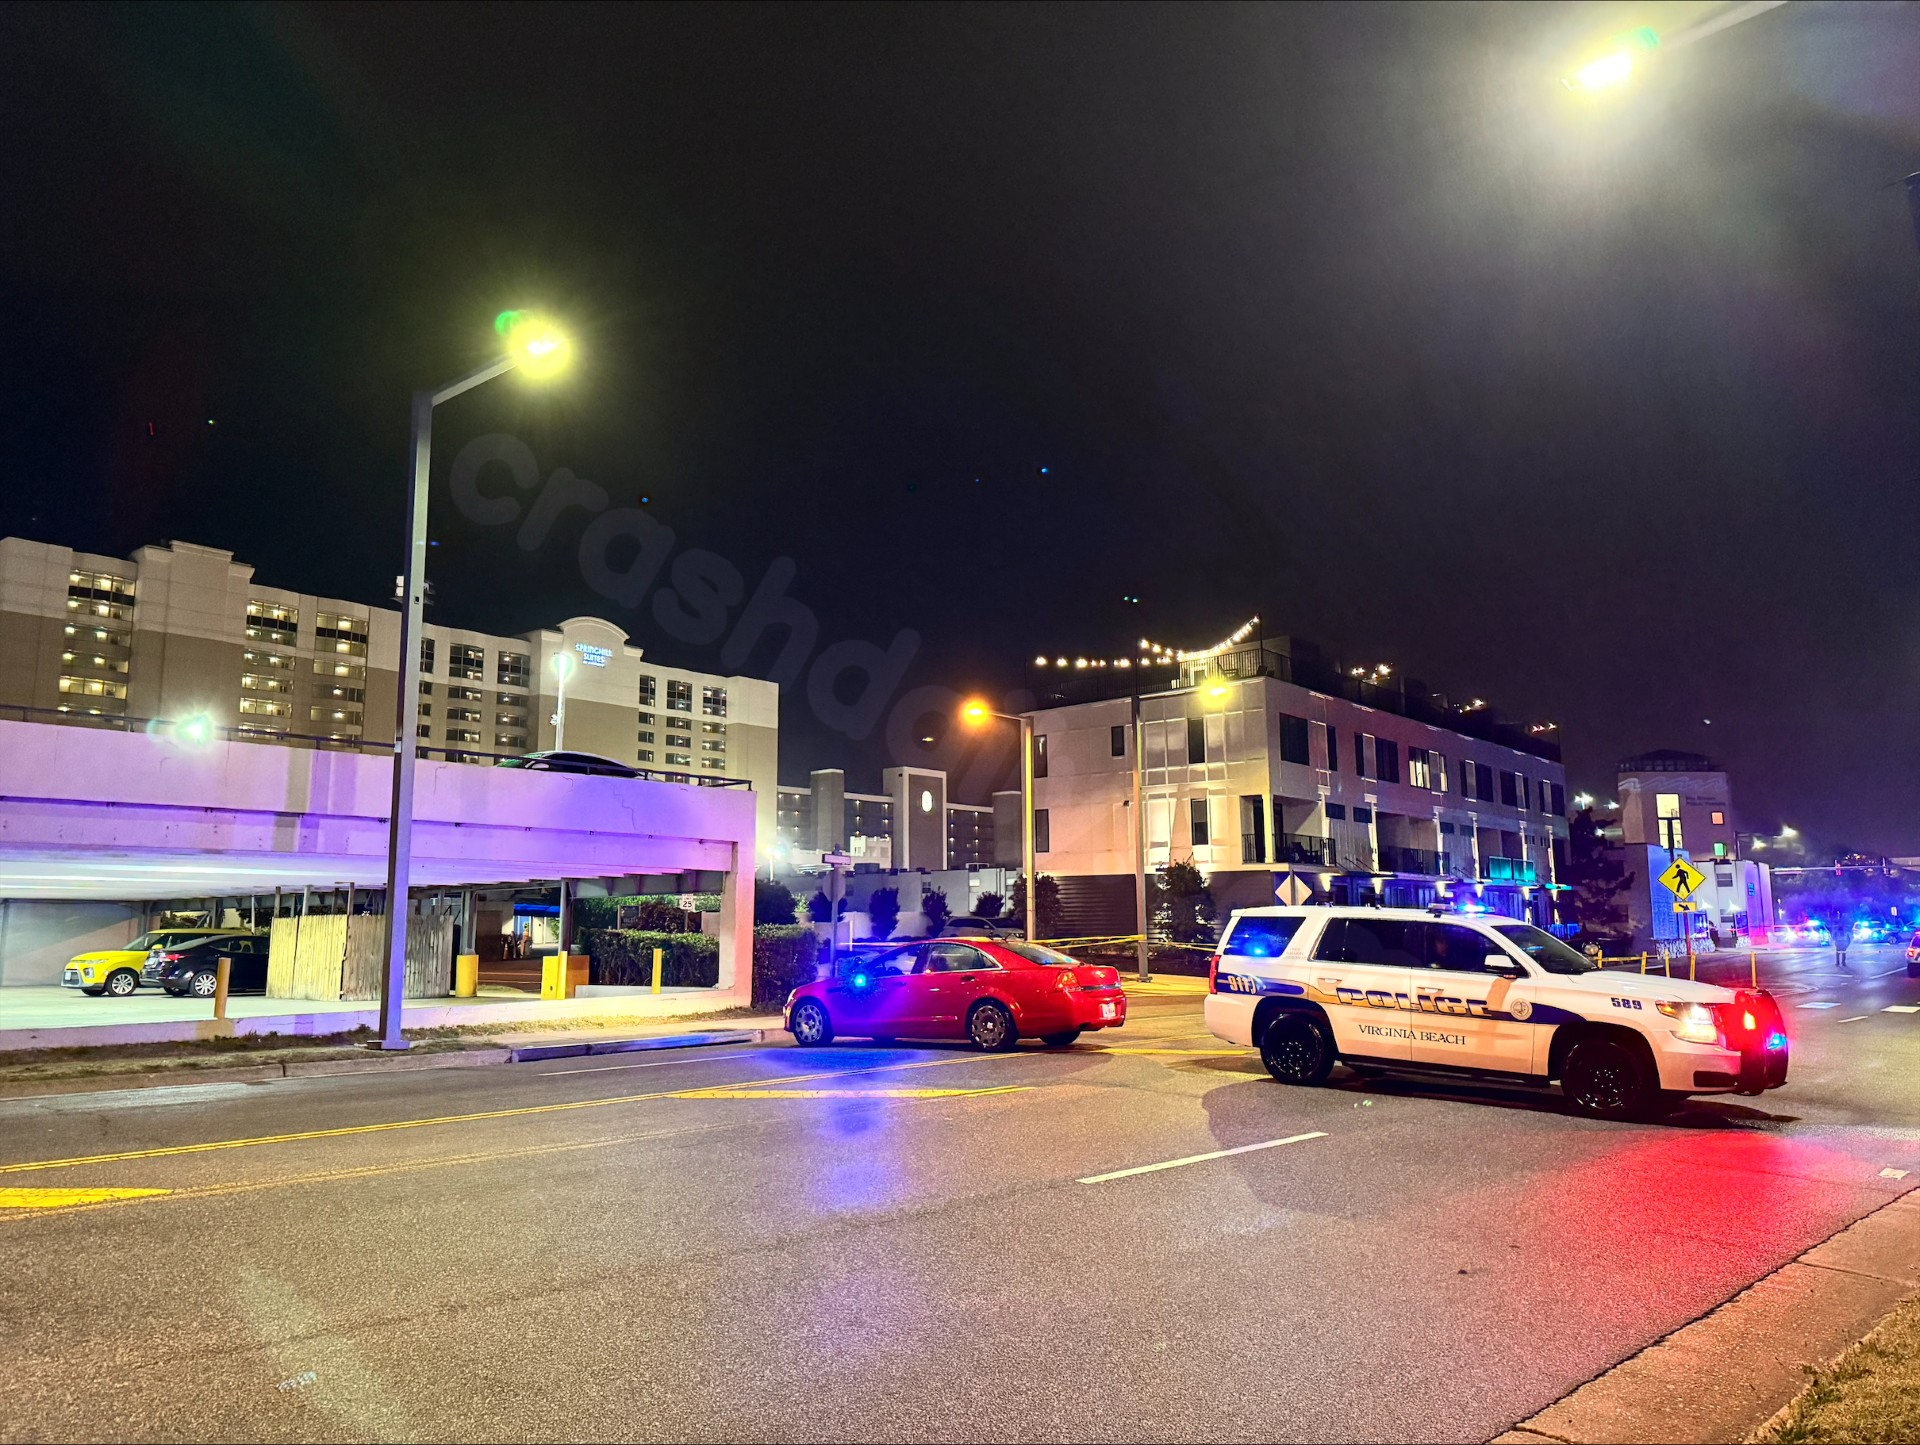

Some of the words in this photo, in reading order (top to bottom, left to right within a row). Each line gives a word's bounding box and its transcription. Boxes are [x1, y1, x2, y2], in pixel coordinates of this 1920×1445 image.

[1336, 987, 1492, 1017] POLICE
[1610, 997, 1642, 1010] 589
[1358, 1024, 1417, 1040] VIRGINIA
[1420, 1031, 1467, 1046] BEACH
